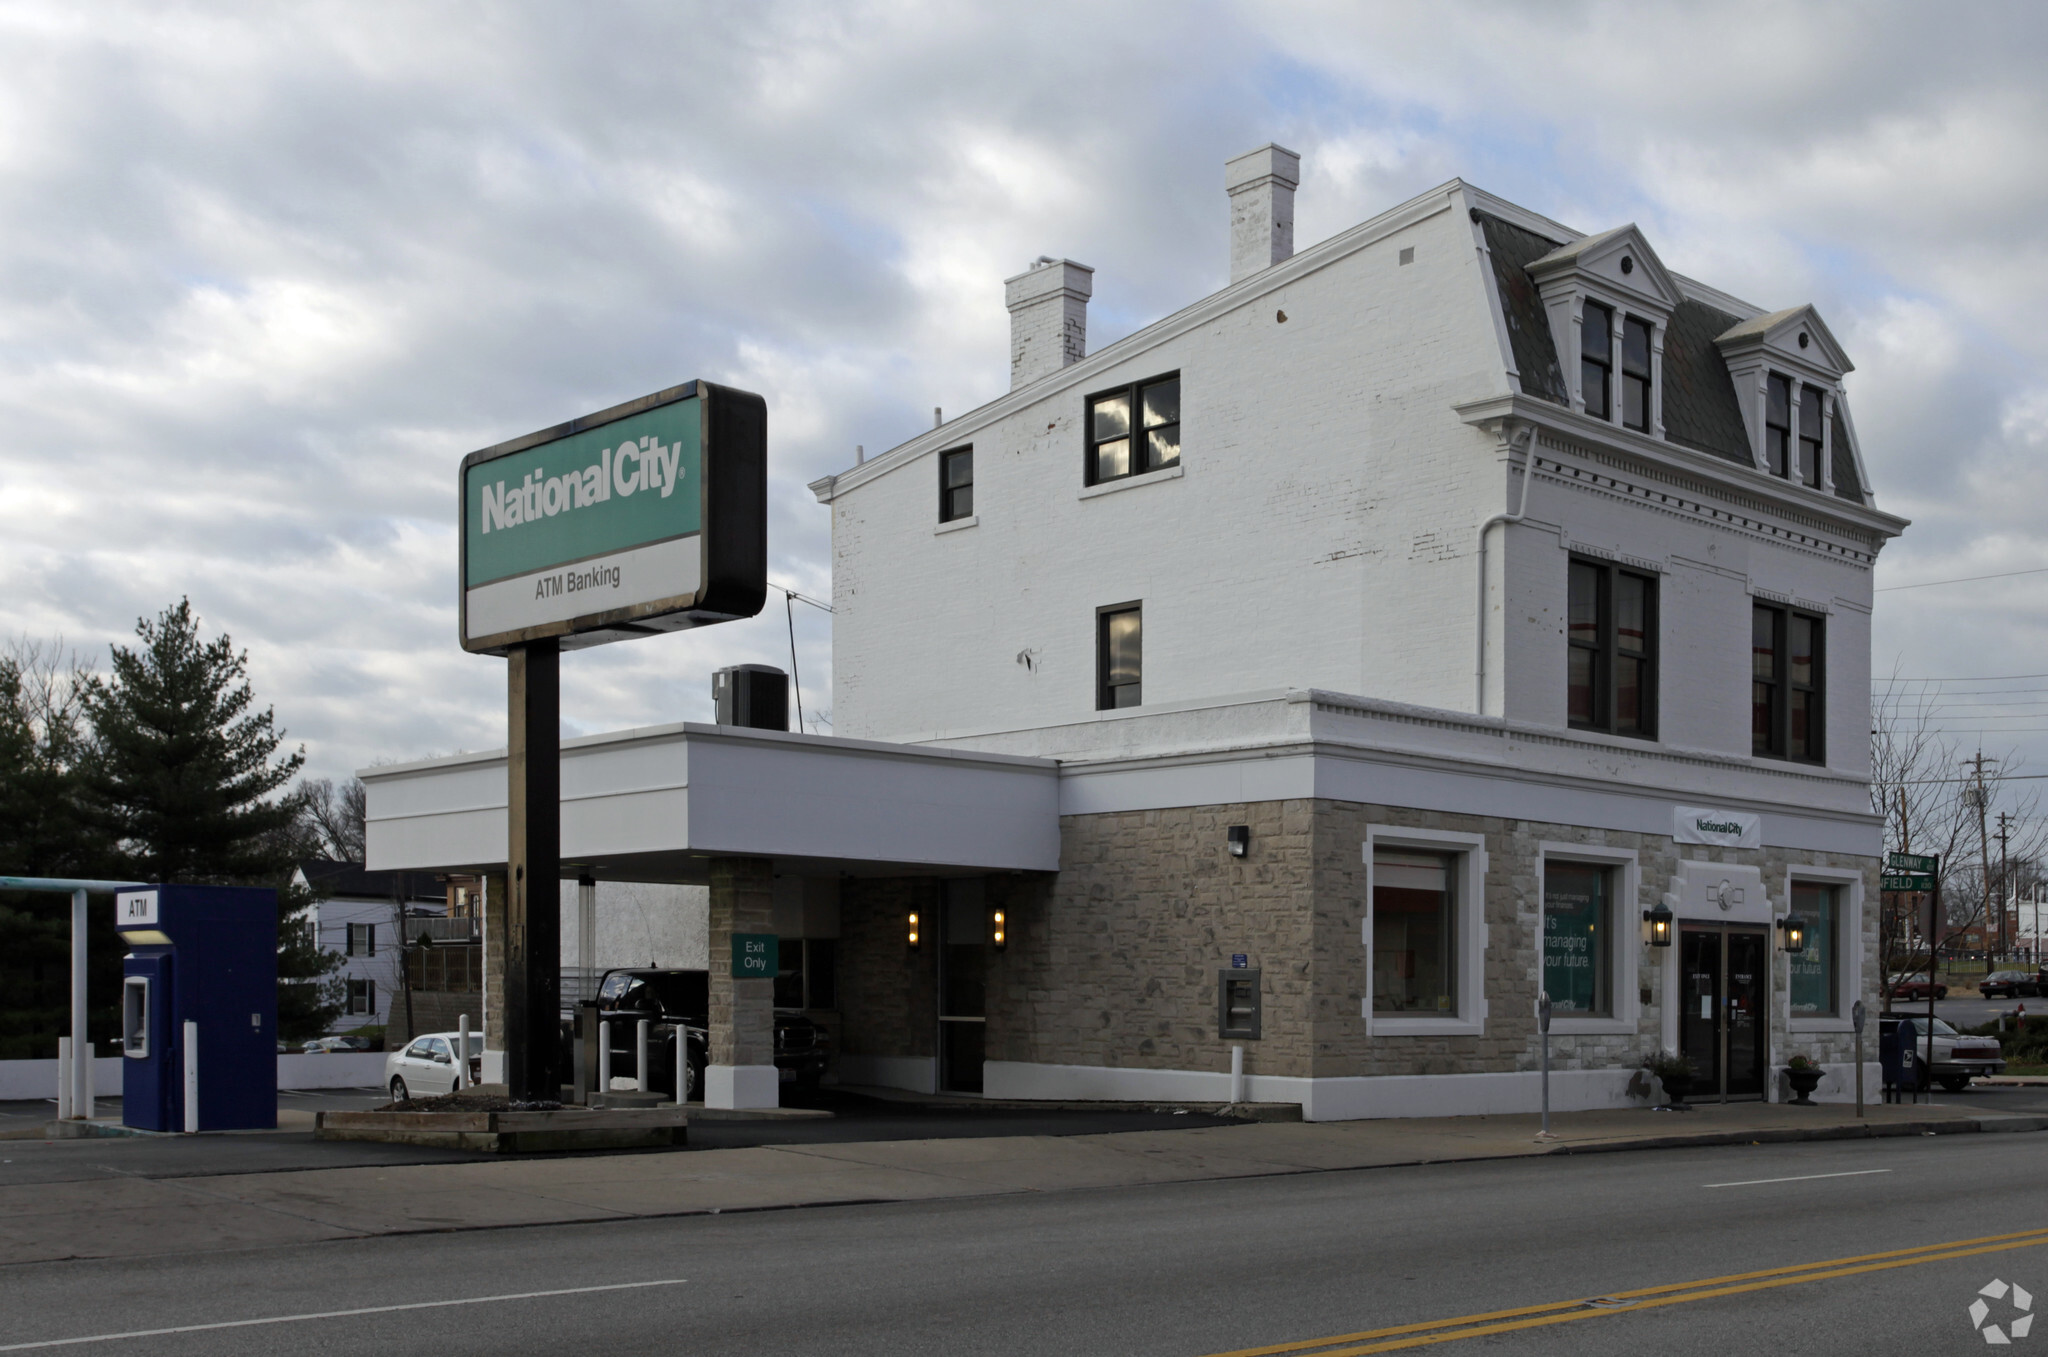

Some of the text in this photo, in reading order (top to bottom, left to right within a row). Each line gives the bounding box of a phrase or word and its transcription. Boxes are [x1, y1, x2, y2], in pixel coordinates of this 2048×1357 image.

[535, 565, 621, 600] ATM Banking
[1890, 855, 1922, 869] GLENWAY
[1880, 877, 1913, 889] NFIELD
[128, 898, 147, 917] ATM
[745, 941, 764, 953] Exit
[744, 957, 766, 971] Only
[1790, 963, 1801, 974] our
